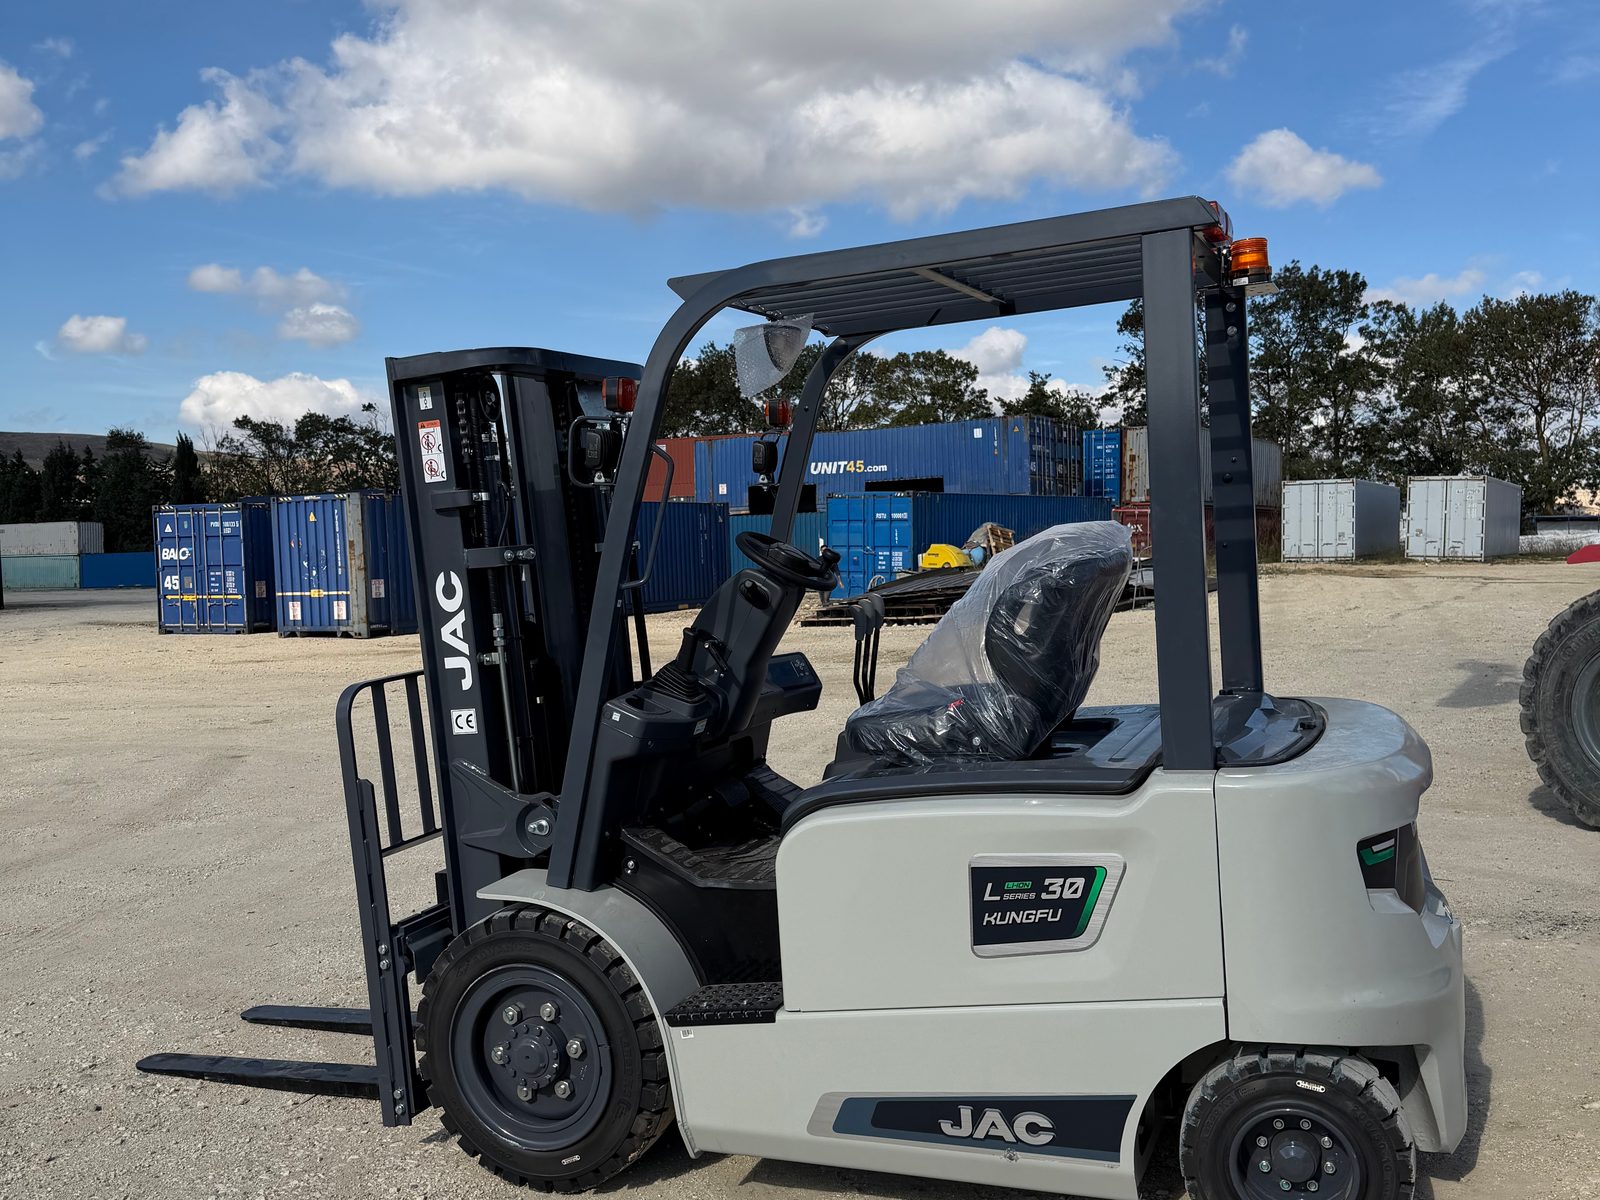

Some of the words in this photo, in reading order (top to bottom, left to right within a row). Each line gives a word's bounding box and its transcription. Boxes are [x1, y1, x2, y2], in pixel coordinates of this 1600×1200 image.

[810, 460, 888, 475] UNIT45.com
[164, 575, 180, 590] 45
[435, 570, 473, 691] JAC
[455, 713, 475, 730] CE
[983, 882, 1001, 901] L
[1003, 892, 1036, 900] SERIES
[1040, 877, 1085, 900] 30
[982, 908, 1063, 926] KUNGFU
[938, 1105, 1057, 1146] JAC
